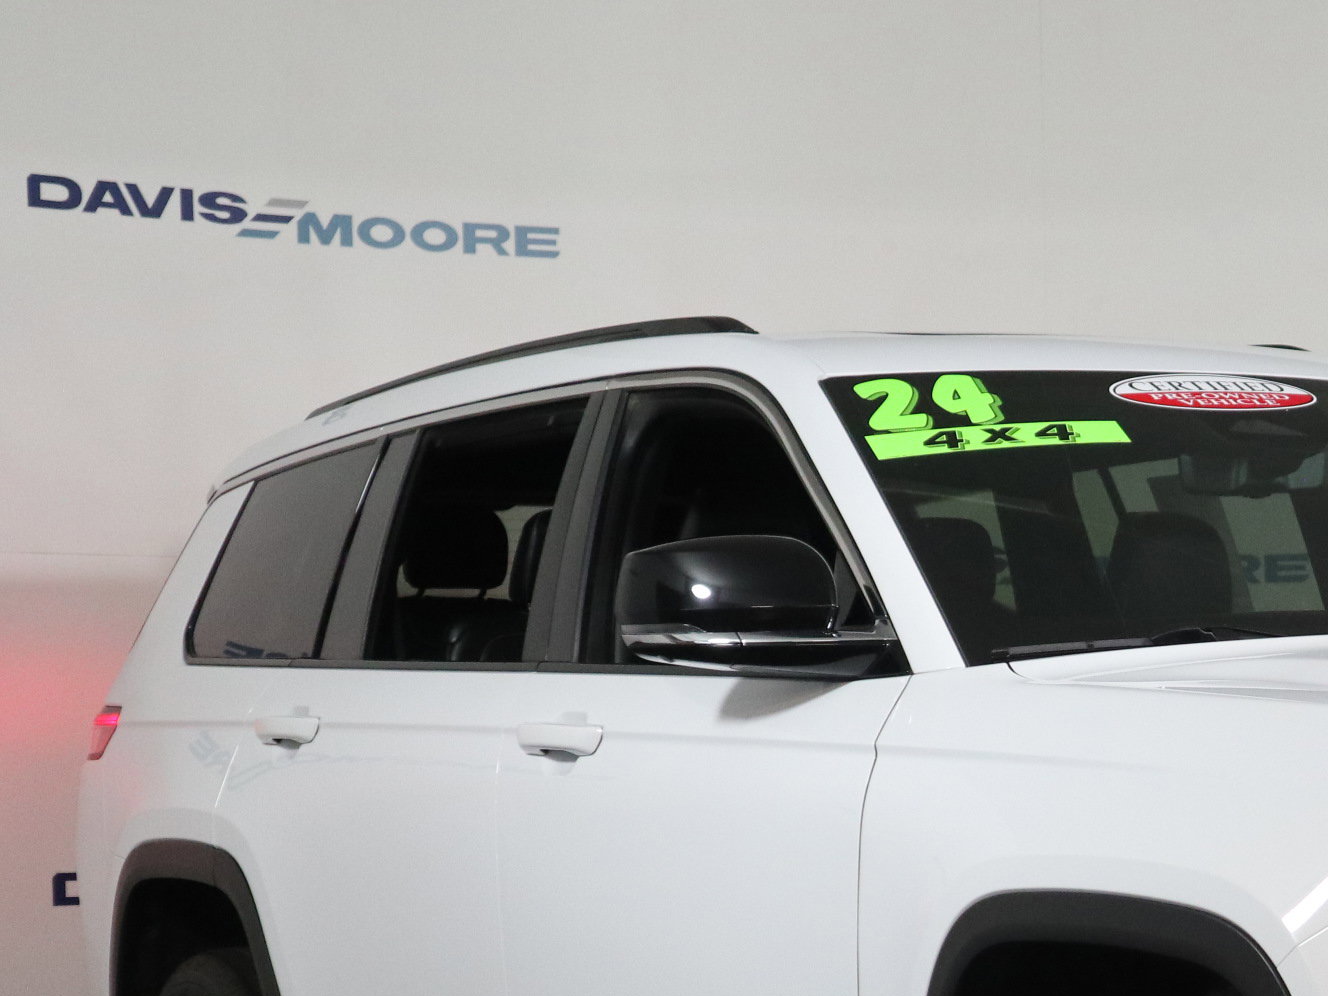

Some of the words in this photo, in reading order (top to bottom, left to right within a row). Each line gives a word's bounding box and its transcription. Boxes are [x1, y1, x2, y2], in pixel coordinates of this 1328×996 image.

[27, 173, 248, 226] DAVIS
[296, 211, 561, 259] MOORE
[1128, 380, 1285, 393] CERTIFIED
[1151, 391, 1290, 401] PRE-OWNED
[1181, 398, 1281, 406] VEHICLE
[853, 374, 1005, 433] 24
